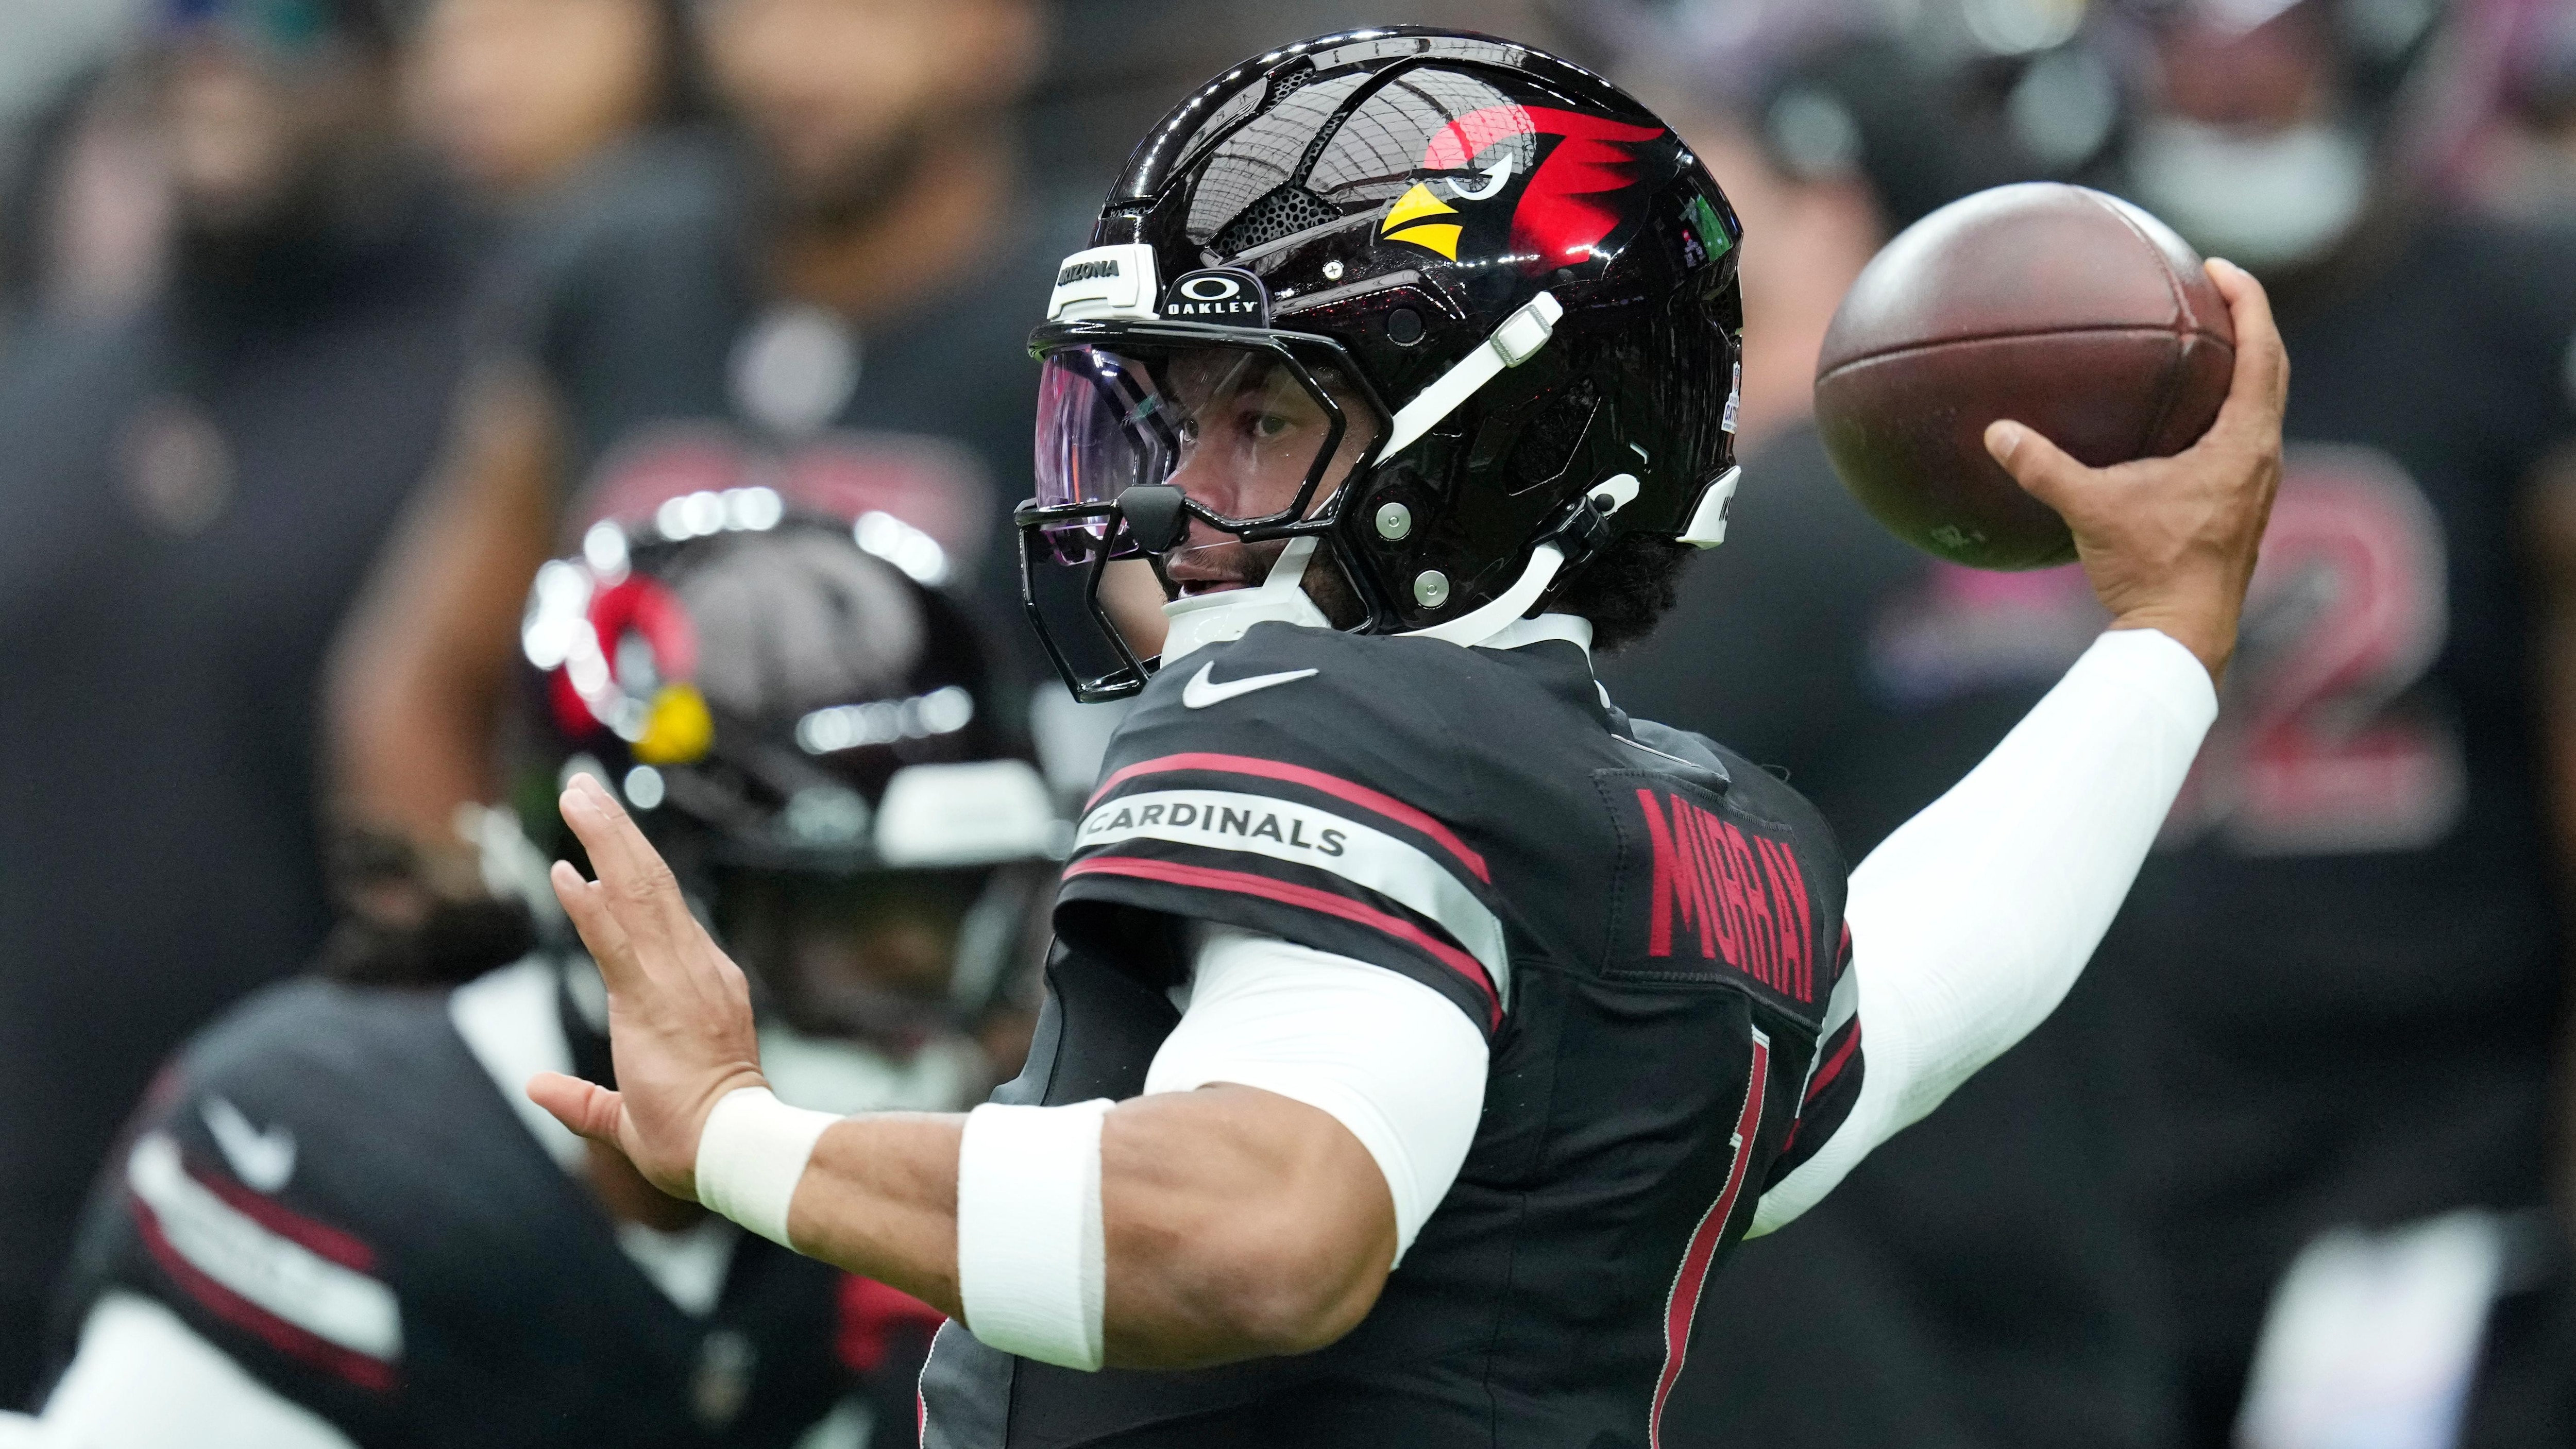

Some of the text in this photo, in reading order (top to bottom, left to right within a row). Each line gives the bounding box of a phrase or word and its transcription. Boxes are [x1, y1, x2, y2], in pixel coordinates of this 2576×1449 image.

[1058, 260, 1119, 286] ARIZONA
[1168, 301, 1255, 315] OAKLEY
[1087, 803, 1347, 857] CARDINALS
[1635, 789, 1812, 1003] MURRAY
